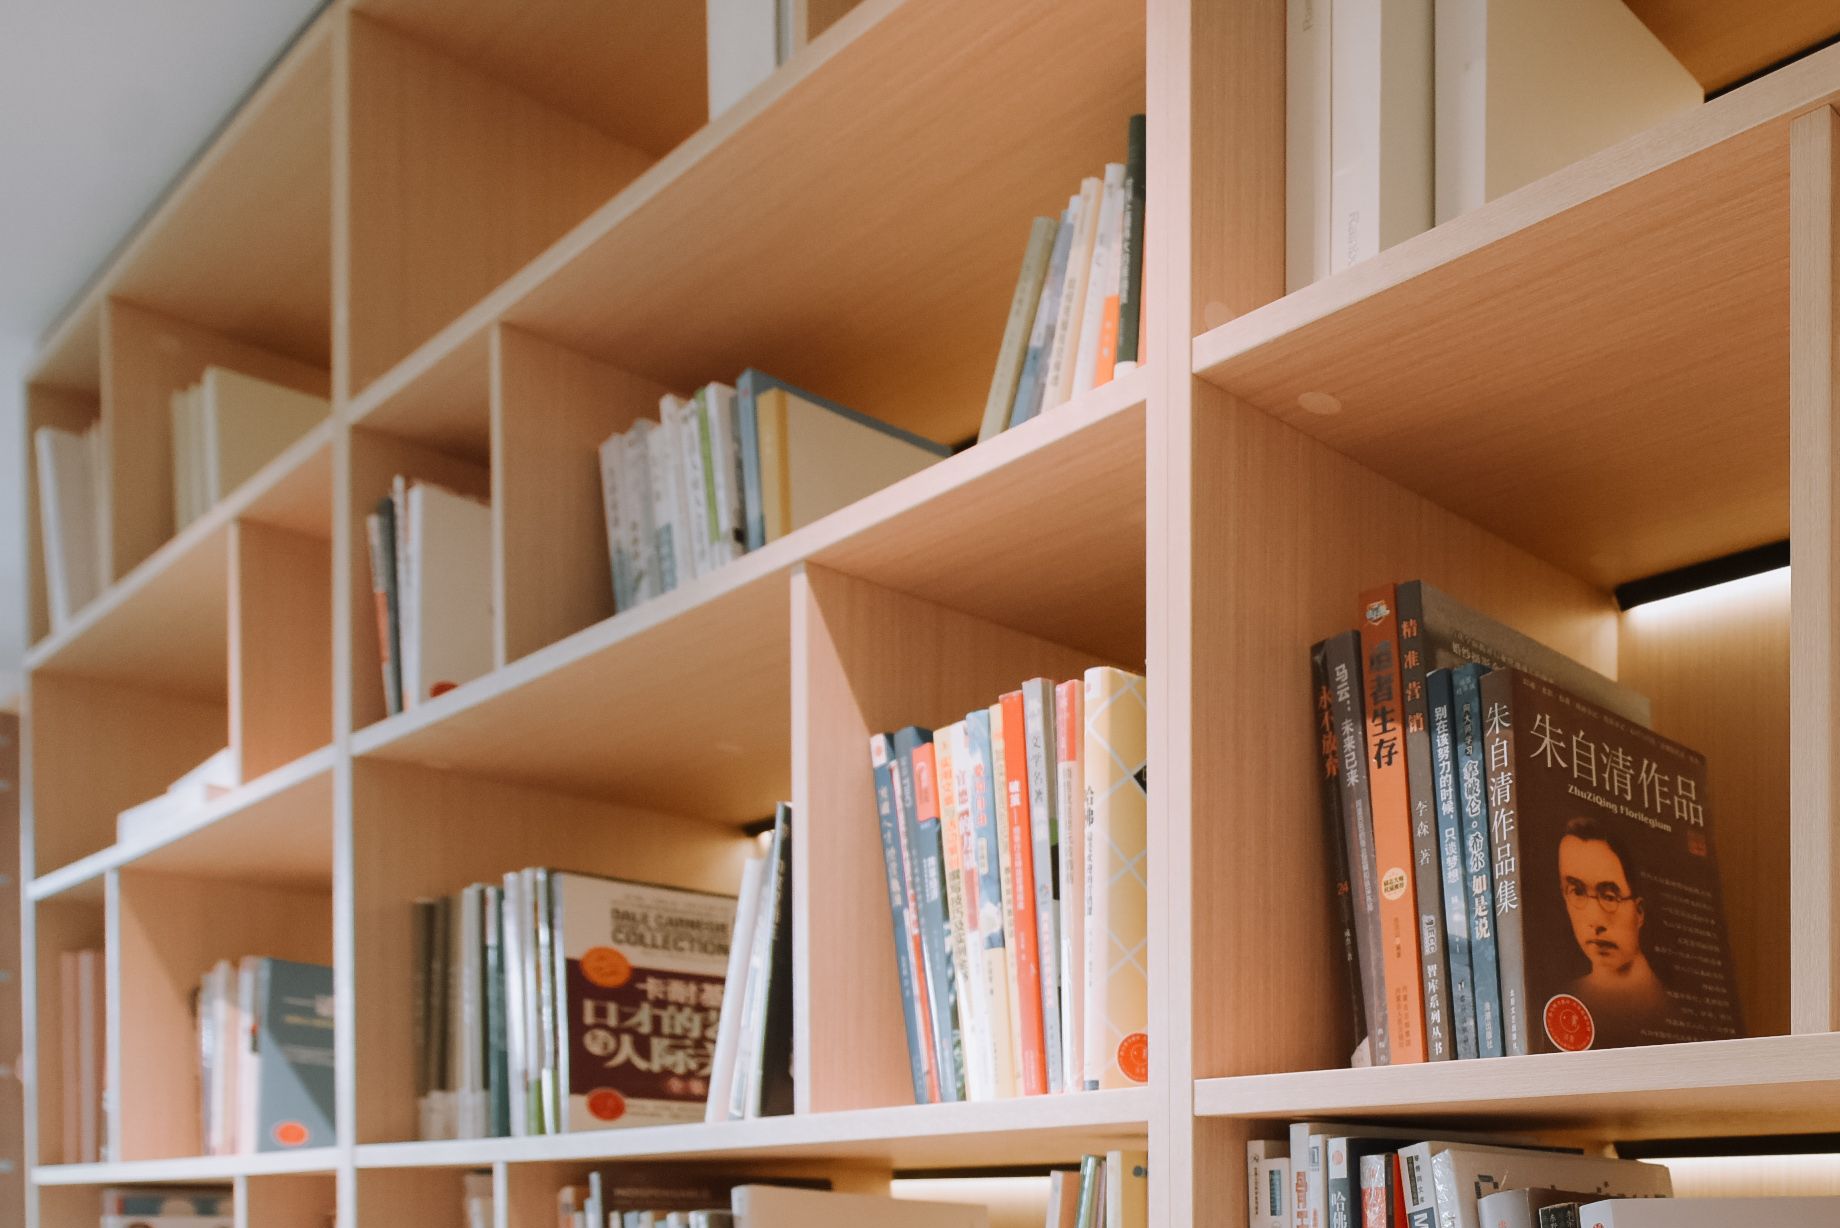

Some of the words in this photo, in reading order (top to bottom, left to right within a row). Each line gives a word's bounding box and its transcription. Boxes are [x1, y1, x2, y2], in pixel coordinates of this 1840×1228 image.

[1402, 618, 1425, 734] 精准营销
[1485, 702, 1520, 915] 朱自清作品集
[1530, 712, 1704, 827] 朱自清作品
[1568, 784, 1618, 814] ZhuZiQing
